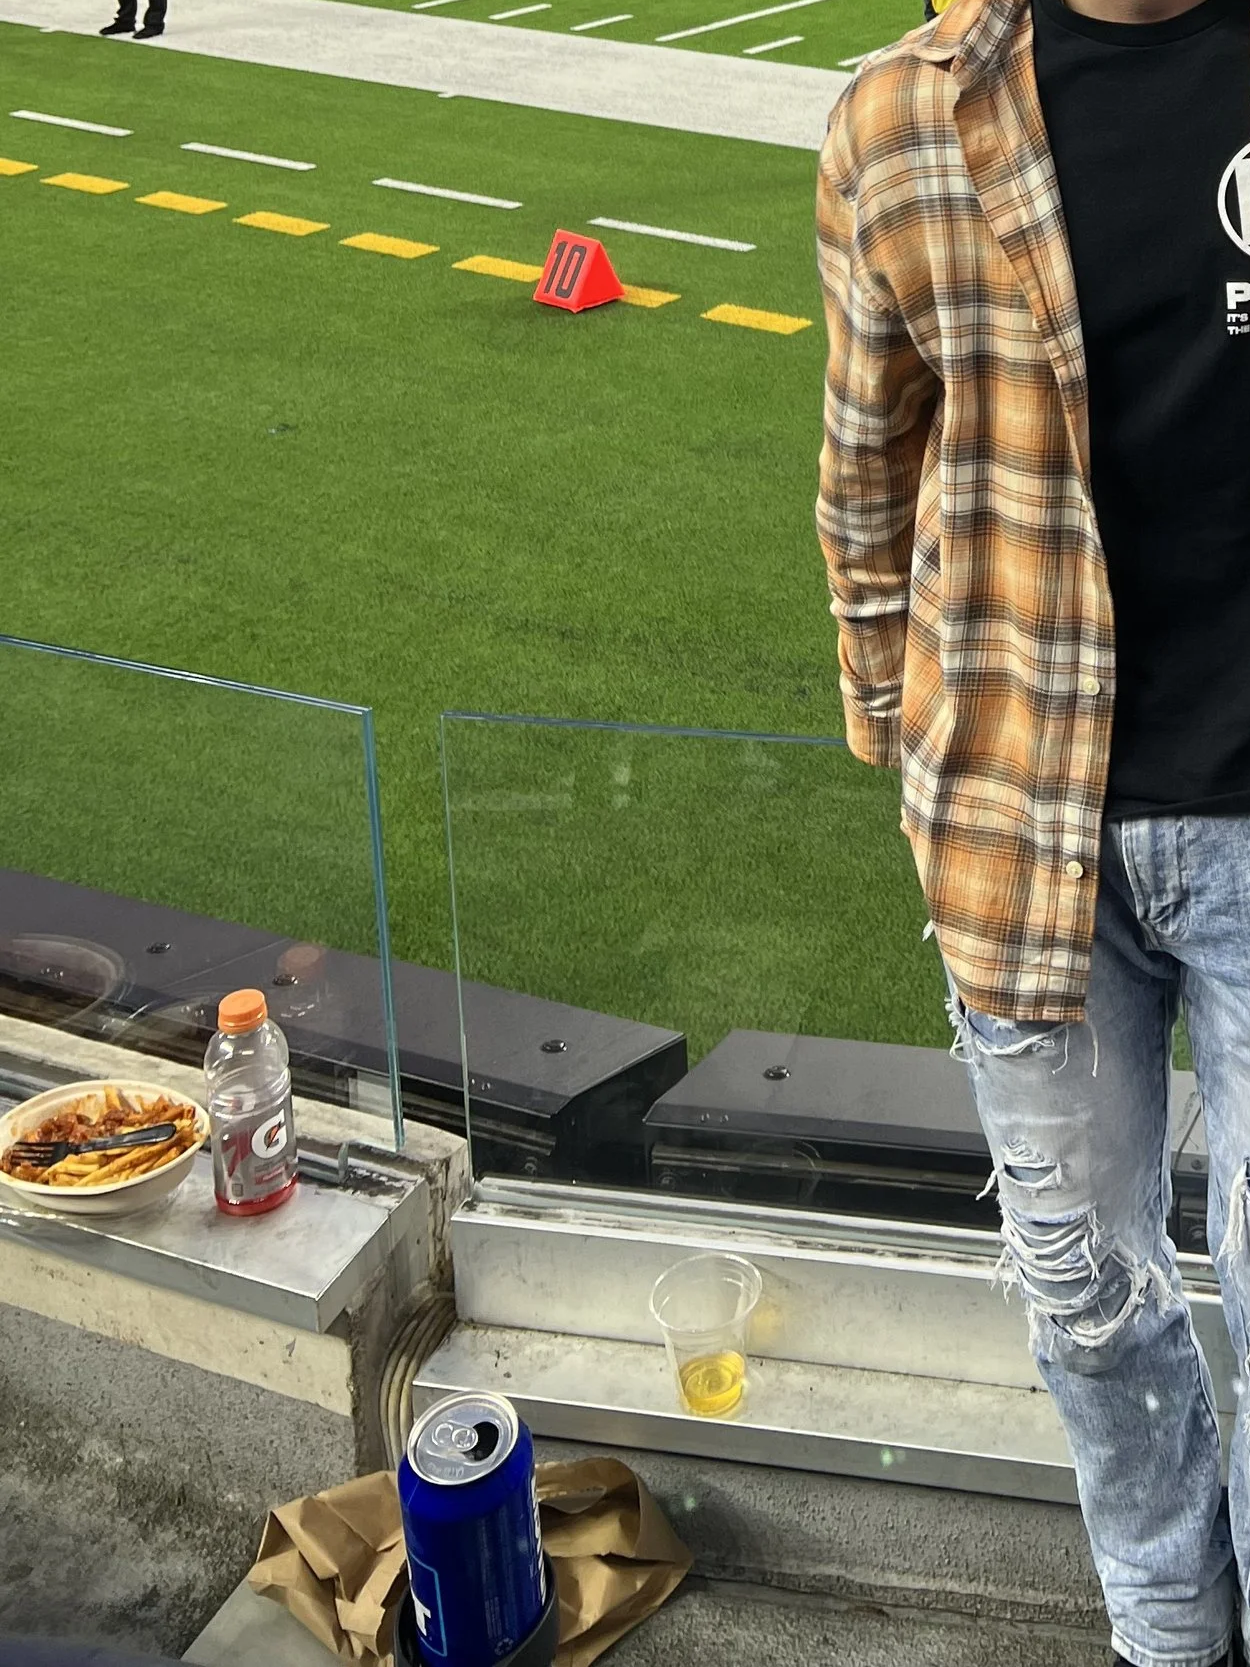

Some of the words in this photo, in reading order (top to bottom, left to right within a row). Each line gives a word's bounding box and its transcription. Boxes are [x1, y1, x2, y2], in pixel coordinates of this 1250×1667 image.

[544, 240, 587, 299] 10
[1226, 325, 1250, 335] THE
[251, 1108, 290, 1160] G
